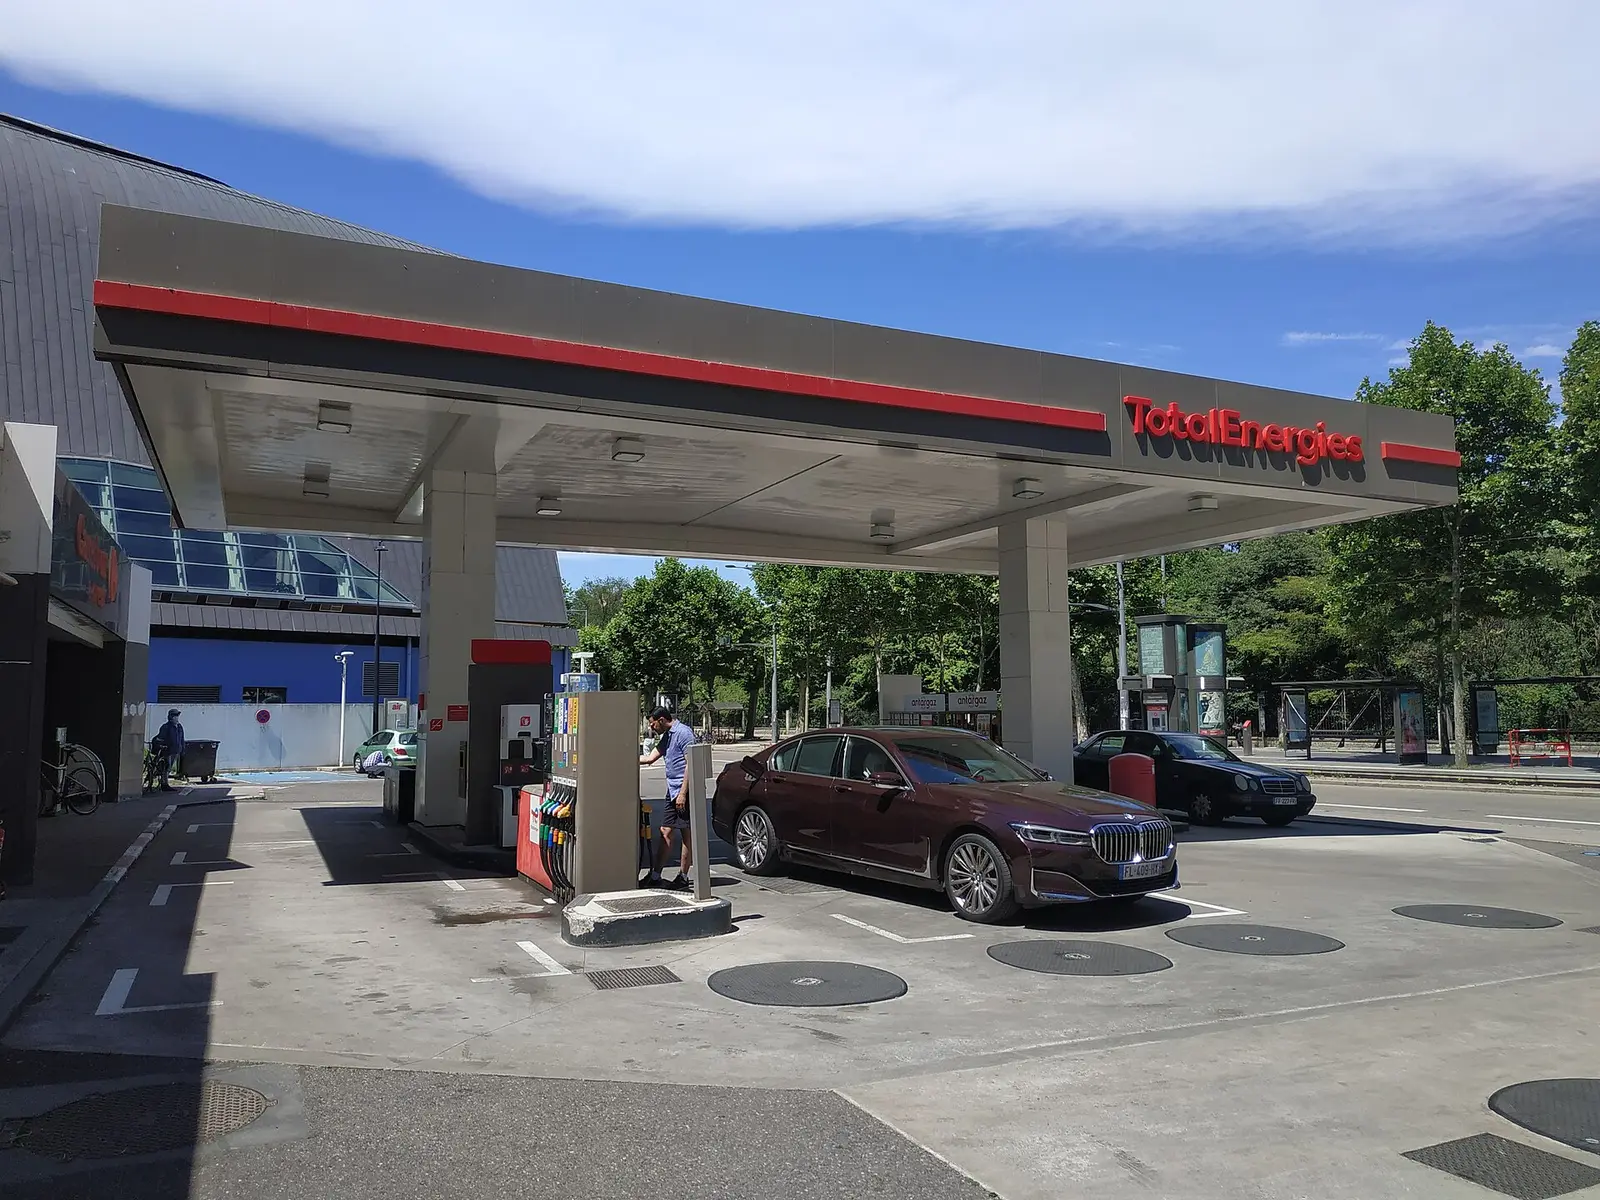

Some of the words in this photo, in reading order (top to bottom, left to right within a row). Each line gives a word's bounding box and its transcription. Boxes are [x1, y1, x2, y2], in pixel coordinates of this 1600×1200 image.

[1123, 395, 1364, 466] TotalEnergies
[392, 702, 402, 710] air
[911, 698, 937, 709] antargaz
[957, 695, 986, 707] antargaz
